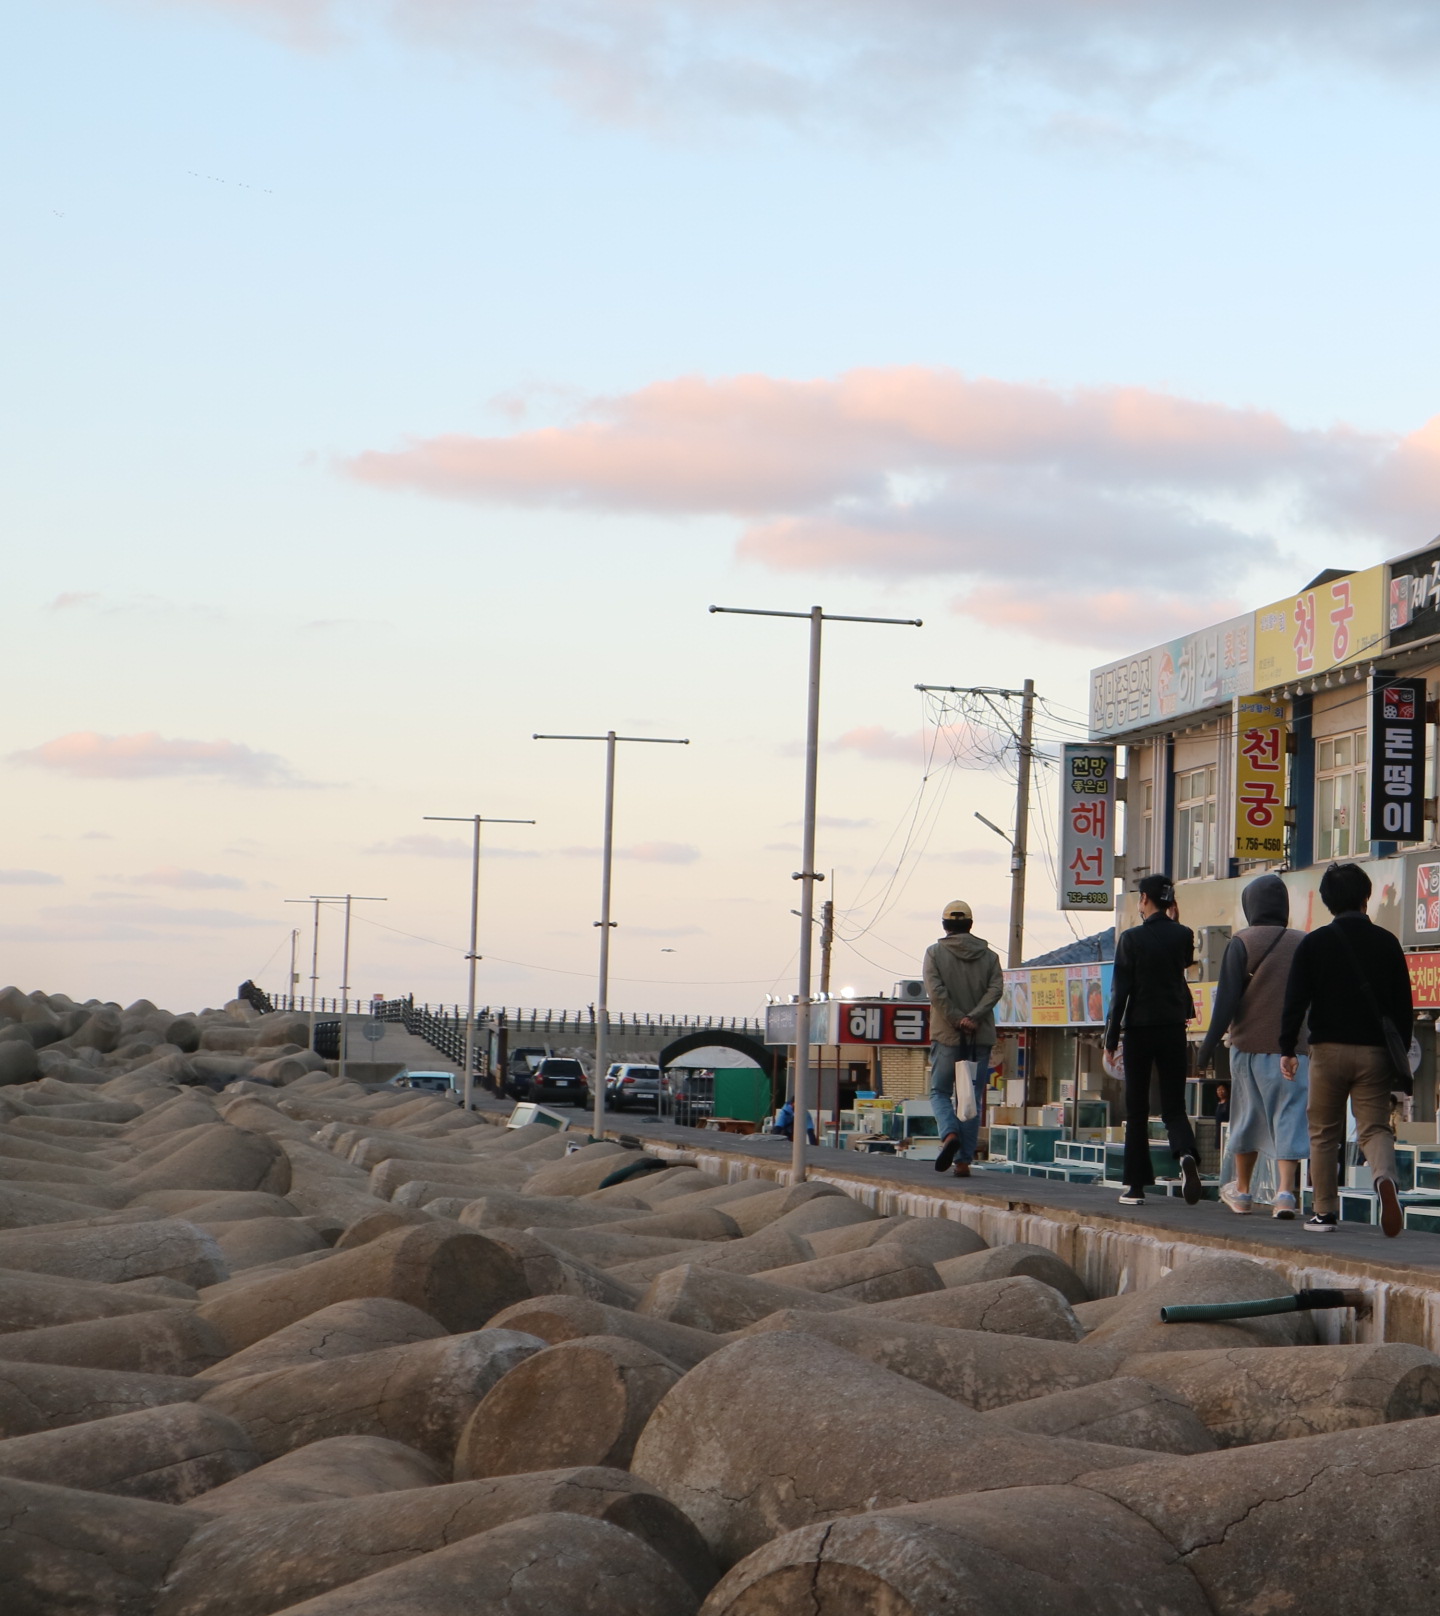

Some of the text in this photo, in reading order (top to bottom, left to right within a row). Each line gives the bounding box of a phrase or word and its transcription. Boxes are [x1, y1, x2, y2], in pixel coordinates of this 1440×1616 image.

[1293, 579, 1355, 674] 천궁
[1093, 655, 1153, 730] 전망좋은집
[1178, 633, 1219, 708] 해선
[1072, 756, 1107, 777] 전망
[1072, 779, 1108, 794] 좋은집
[1240, 728, 1281, 827] 천궁
[1383, 727, 1414, 833] 돈떵이
[1069, 801, 1107, 886] 해선
[1245, 837, 1281, 851] 756-4560
[850, 1006, 924, 1041] 해금
